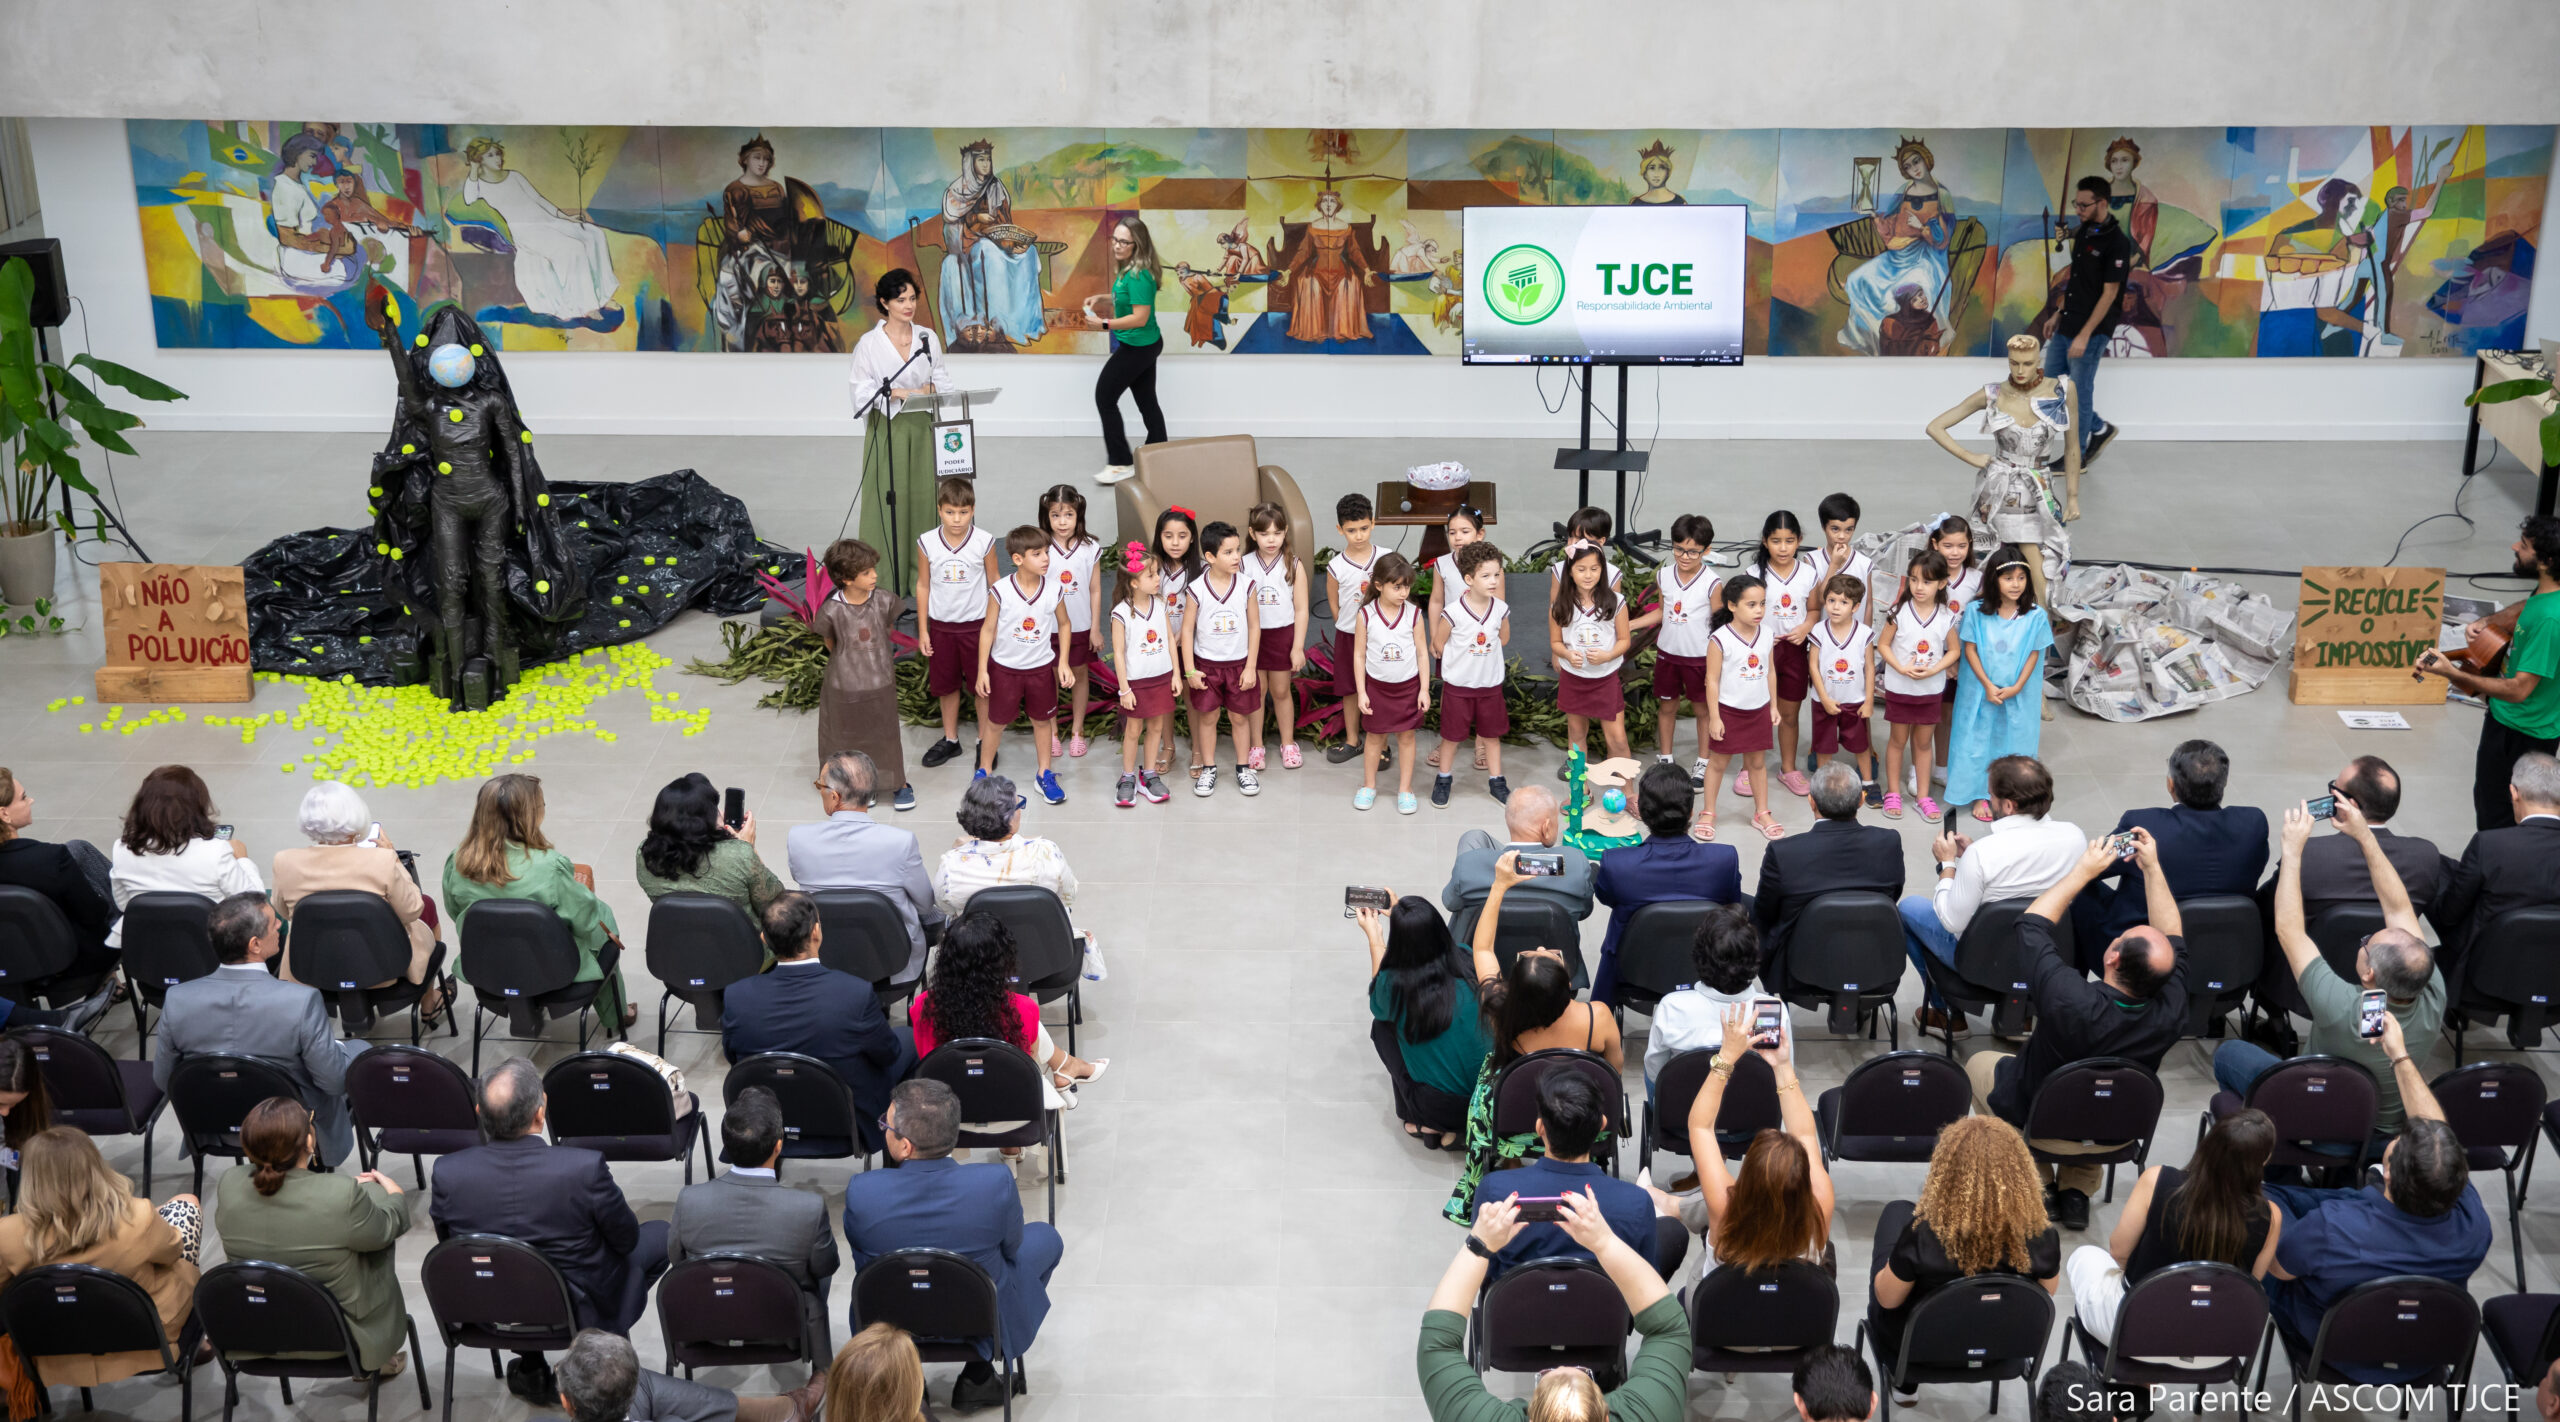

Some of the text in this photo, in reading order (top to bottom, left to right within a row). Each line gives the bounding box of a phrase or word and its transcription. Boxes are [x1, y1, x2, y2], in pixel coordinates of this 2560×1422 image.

[1596, 263, 1693, 296] TJCE
[1577, 301, 1713, 311] Responsabilidade Ambiental
[140, 573, 190, 607] NÃO
[2333, 588, 2421, 616] RECICLE
[158, 609, 175, 632] A
[2360, 617, 2375, 634] O
[128, 633, 250, 667] POLUIÇÃO
